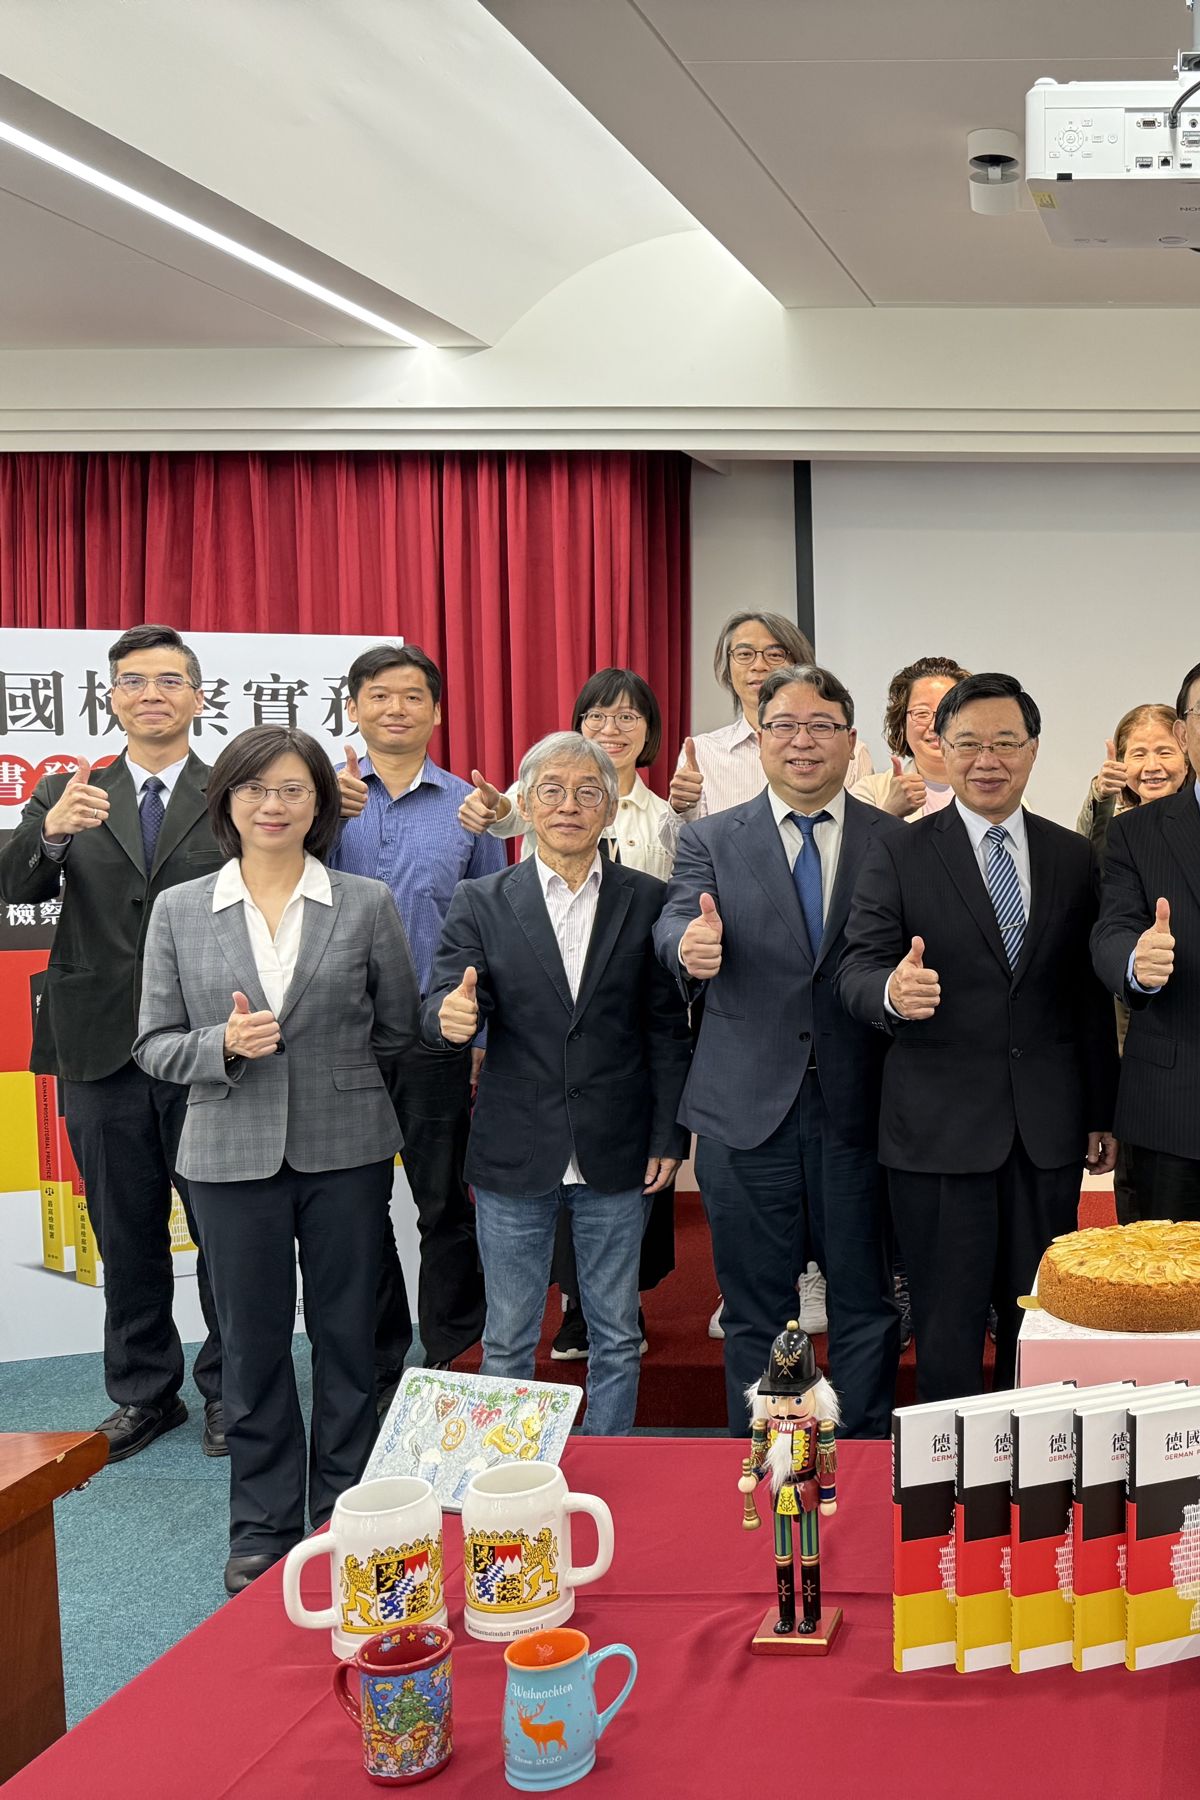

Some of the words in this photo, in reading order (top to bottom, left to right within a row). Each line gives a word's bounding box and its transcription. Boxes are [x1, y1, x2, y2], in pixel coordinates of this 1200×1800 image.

[931, 1433, 950, 1454] 德
[1165, 1450, 1194, 1460] GERMAN
[511, 1682, 573, 1700] Weihnachten
